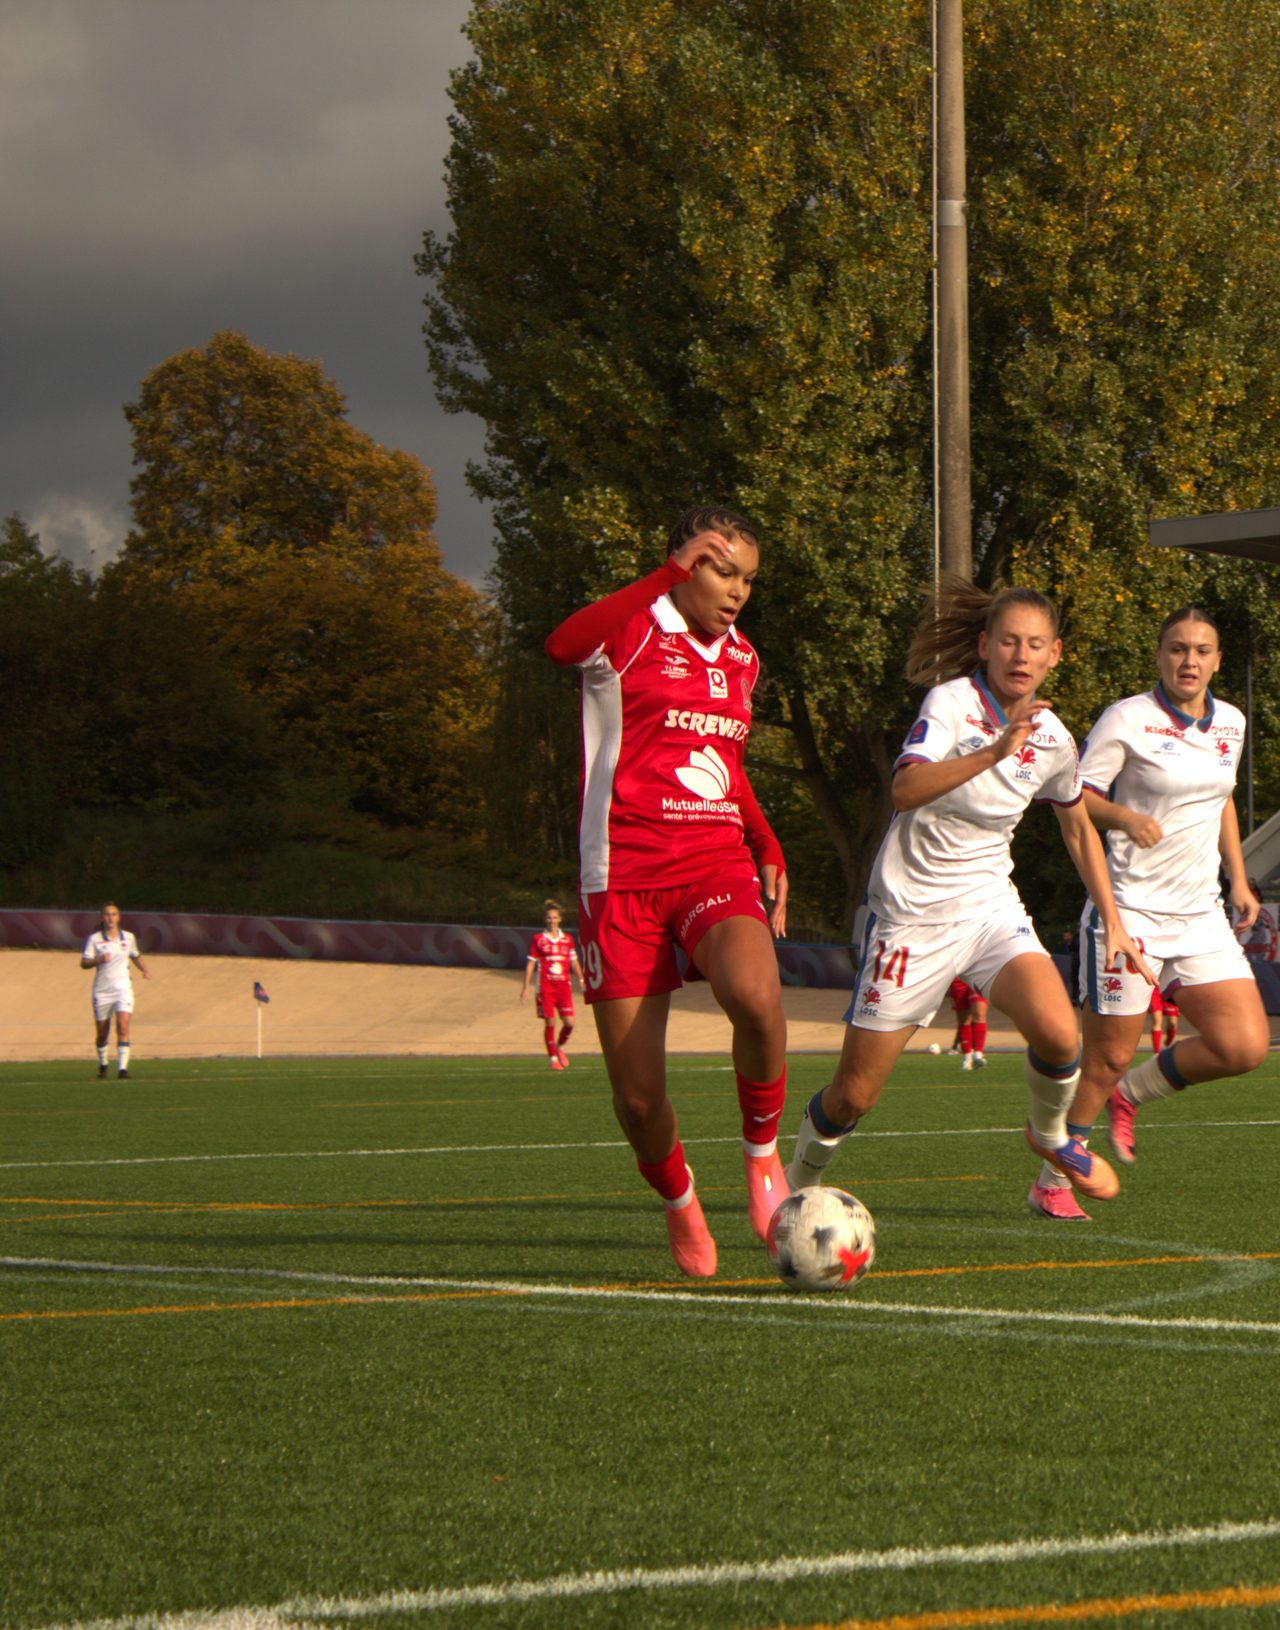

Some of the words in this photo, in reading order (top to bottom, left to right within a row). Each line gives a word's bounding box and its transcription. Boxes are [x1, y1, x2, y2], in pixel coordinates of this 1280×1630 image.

[727, 646, 753, 664] Nord
[665, 709, 749, 743] SCREWFIX
[680, 893, 731, 938] MARCALI
[872, 939, 910, 988] 14
[1103, 994, 1122, 1002] LOSC
[860, 1006, 878, 1017] LOSC
